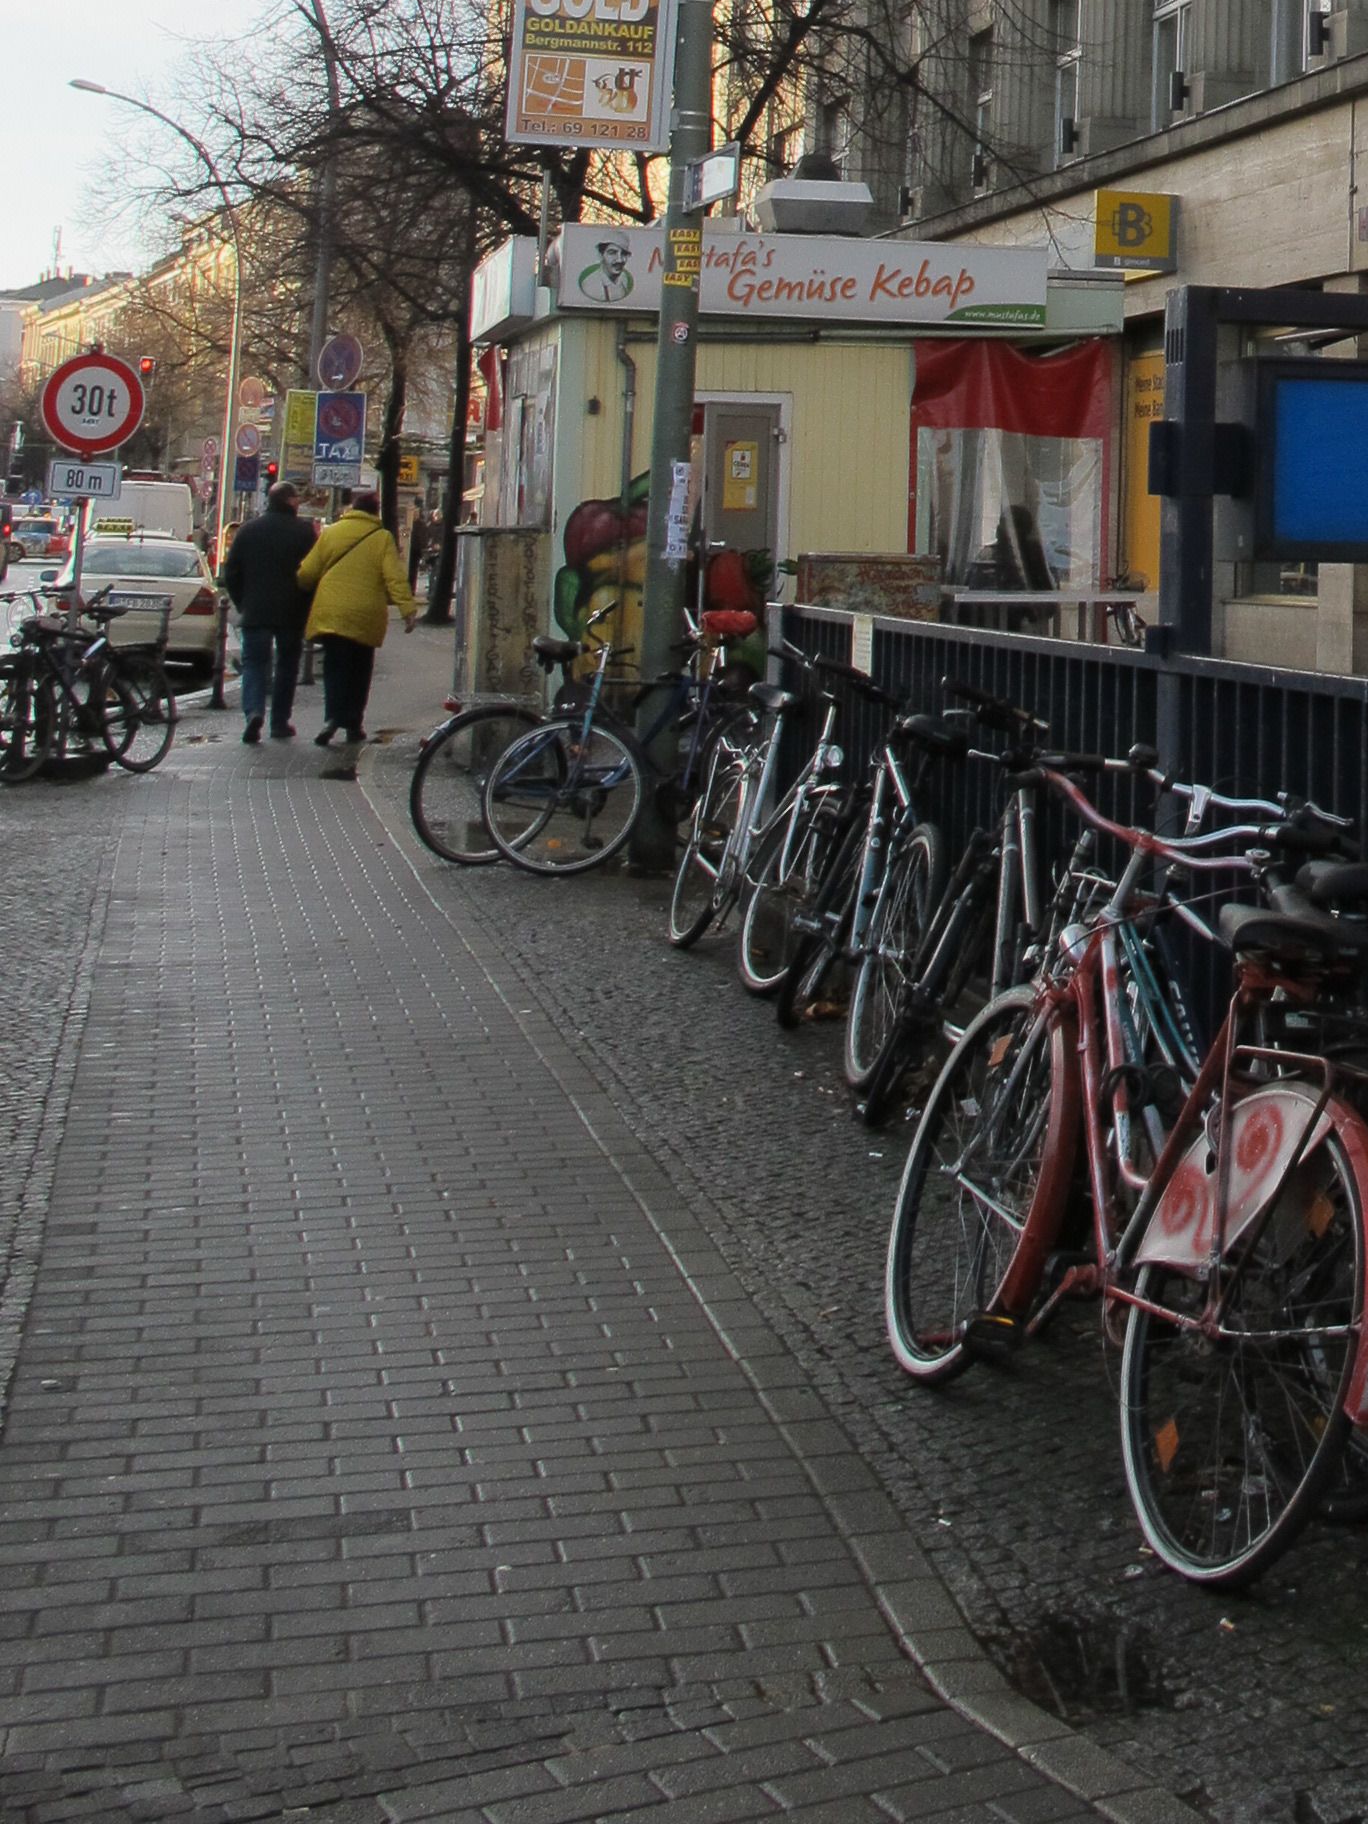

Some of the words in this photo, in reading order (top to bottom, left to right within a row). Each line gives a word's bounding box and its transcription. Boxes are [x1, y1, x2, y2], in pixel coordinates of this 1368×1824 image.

[526, 18, 655, 39] GOLDANKAUF
[525, 33, 622, 52] Bergmannstr.
[626, 40, 653, 54] 112
[563, 121, 583, 135] 69
[590, 124, 620, 137] 121
[626, 126, 647, 139] 28
[727, 268, 858, 306] Gemüse
[869, 259, 976, 308] Kebap
[66, 469, 84, 488] 80
[88, 475, 103, 490] m
